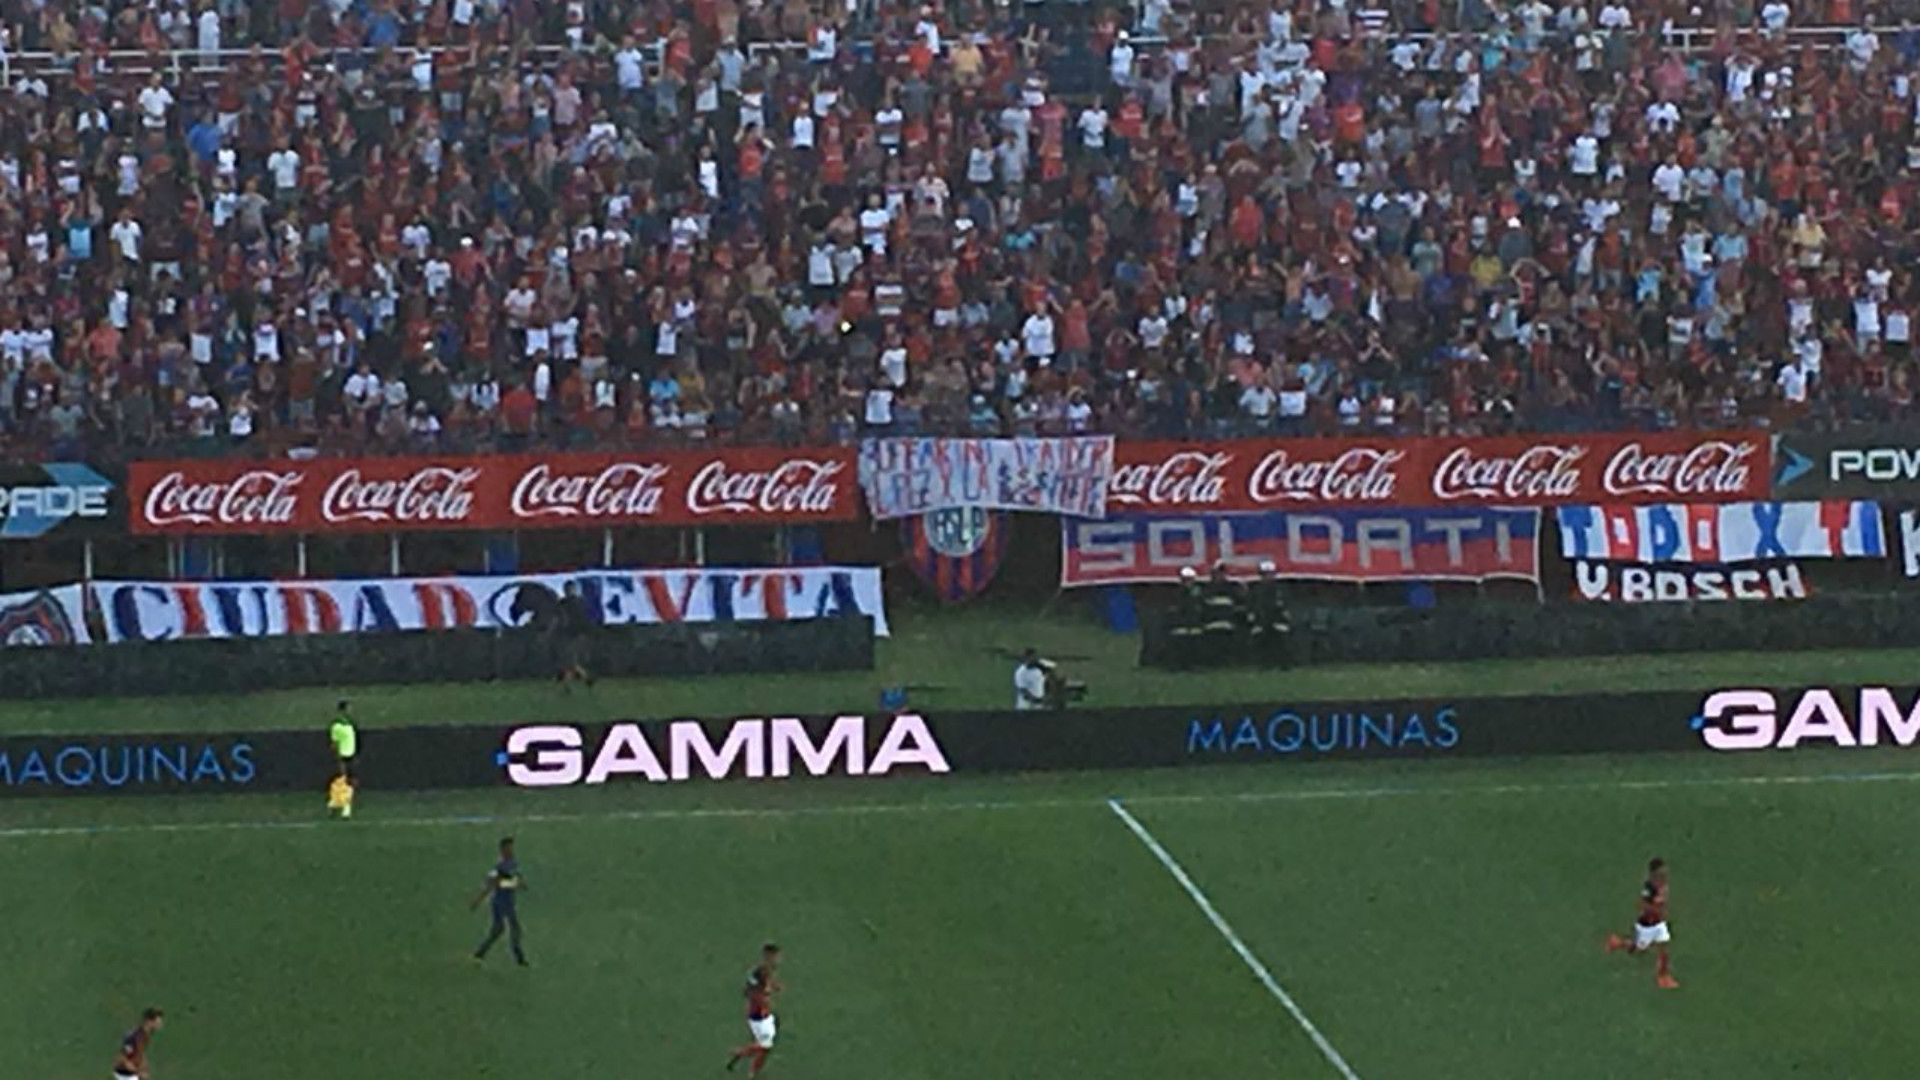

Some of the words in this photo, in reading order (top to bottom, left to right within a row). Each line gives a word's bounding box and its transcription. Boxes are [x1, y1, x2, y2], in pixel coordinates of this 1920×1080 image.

[145, 471, 305, 525] Coca-Cola
[322, 467, 482, 522] Coca-Cola
[511, 463, 670, 517] Coca-Cola
[687, 460, 844, 514] Coca-Cola
[1249, 448, 1407, 503] Coca-Cola
[1433, 445, 1587, 499] Coca-Cola
[1603, 441, 1758, 495] Coca-Cola
[1077, 513, 1514, 572] SOLDATI
[1560, 502, 1722, 562] TODO
[1752, 501, 1788, 558] X
[112, 582, 478, 640] CIUDAD
[507, 715, 950, 785] GAMMA
[1188, 708, 1460, 753] MAQUINAS
